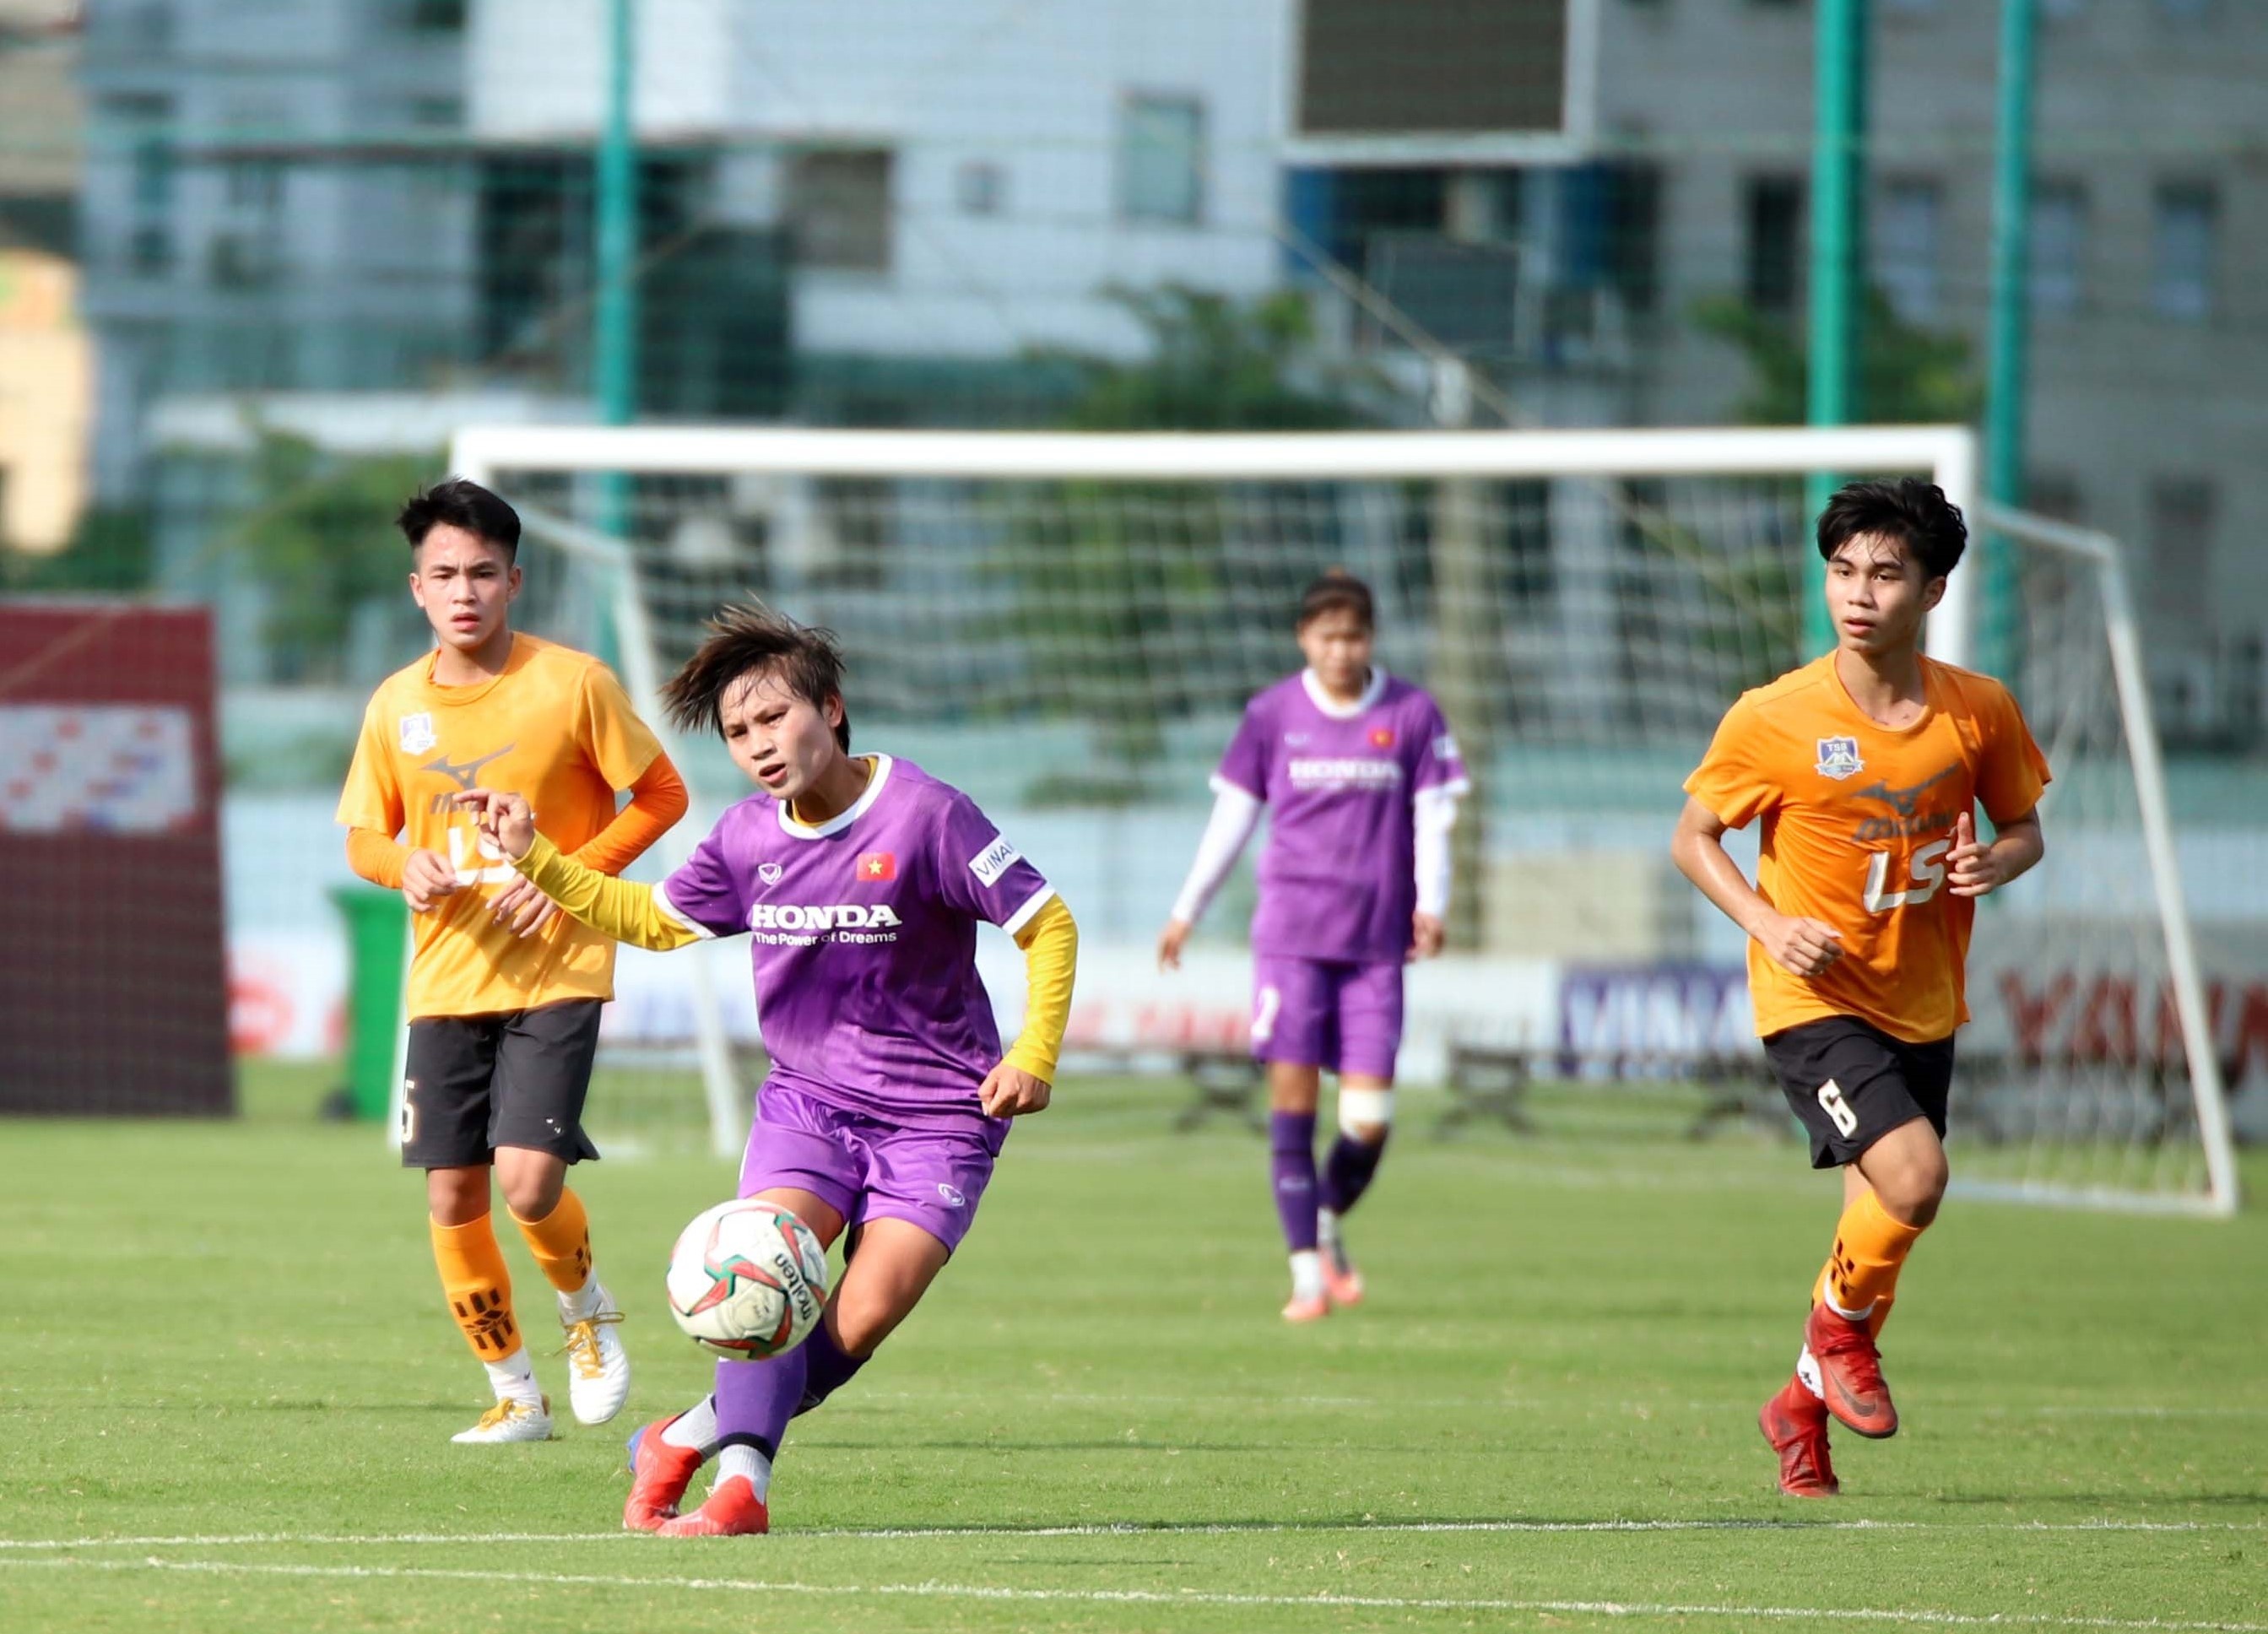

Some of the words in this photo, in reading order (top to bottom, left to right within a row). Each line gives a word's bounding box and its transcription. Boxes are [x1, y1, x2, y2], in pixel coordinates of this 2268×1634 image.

[1863, 839, 1951, 913] LS
[752, 904, 902, 929] HONDA
[755, 932, 777, 945] The
[778, 933, 818, 946] Power
[821, 932, 836, 943] of
[839, 931, 897, 944] Dreams
[1818, 1078, 1858, 1138] 6
[774, 1253, 814, 1321] molten
